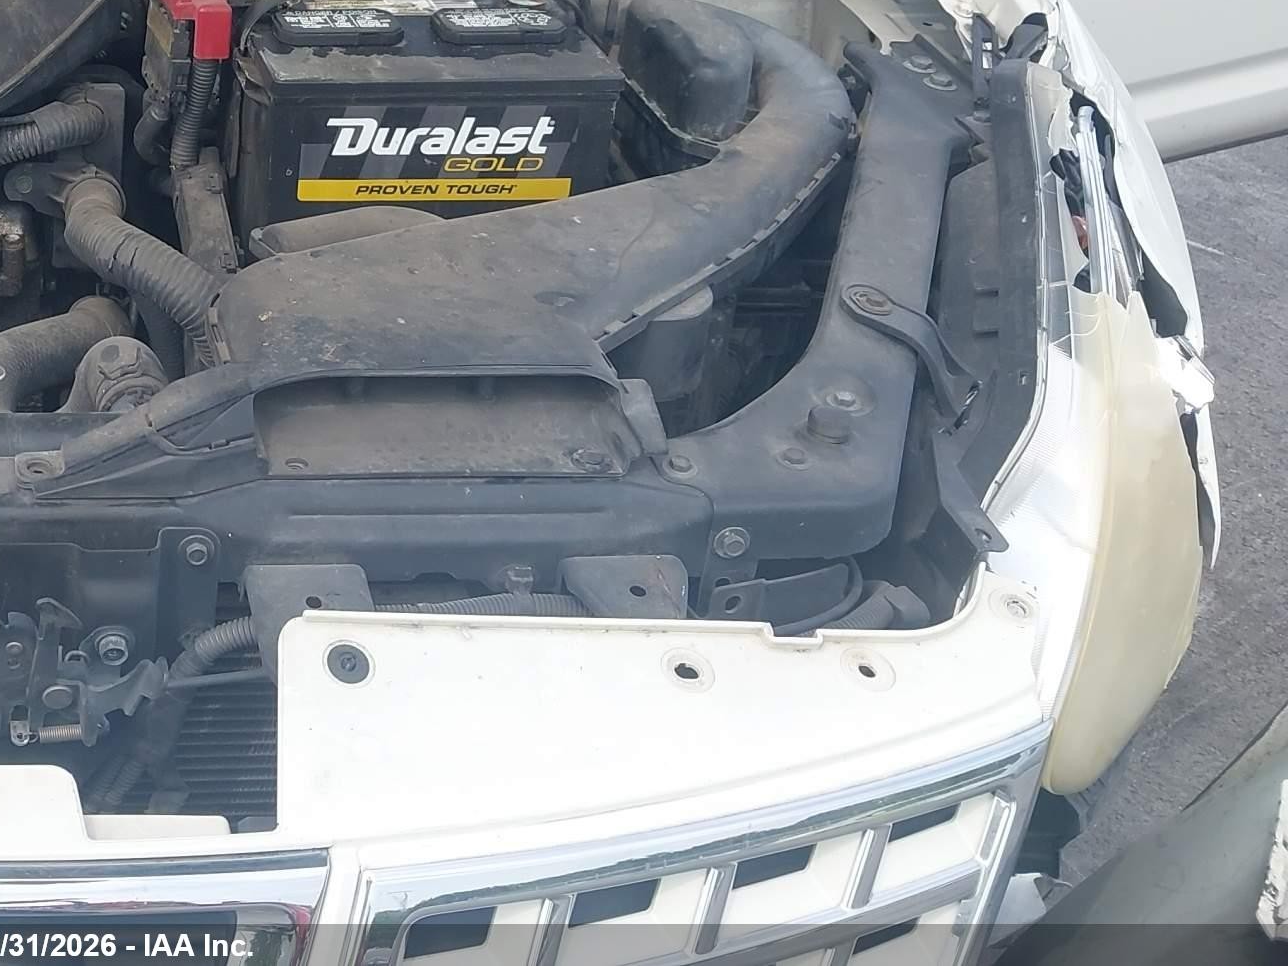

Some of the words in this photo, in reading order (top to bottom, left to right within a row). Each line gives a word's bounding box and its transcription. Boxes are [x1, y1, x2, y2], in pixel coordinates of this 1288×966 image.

[326, 116, 555, 156] Duralast
[444, 157, 544, 172] GOLD
[355, 184, 440, 195] PROVEN
[446, 184, 514, 195] TOUGH
